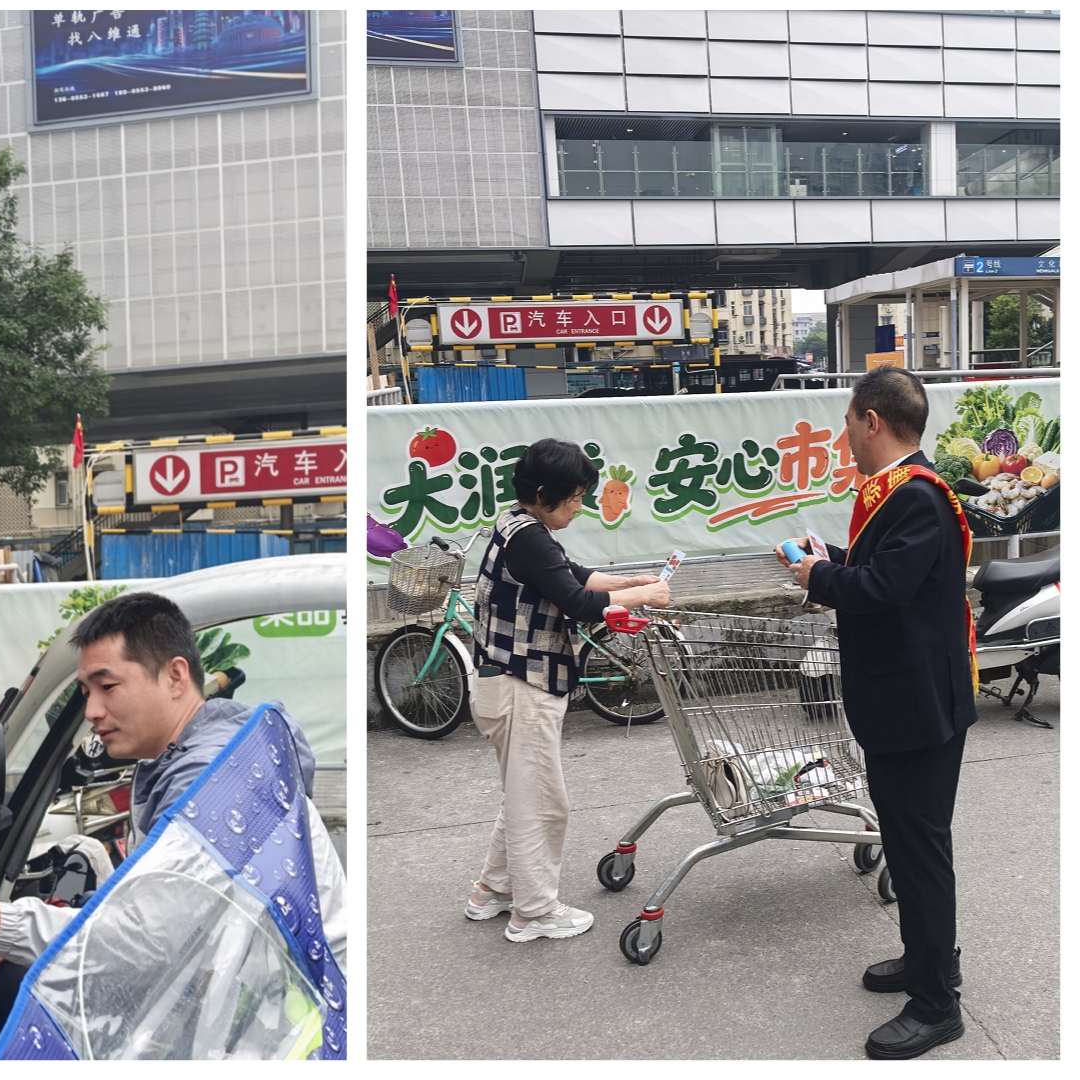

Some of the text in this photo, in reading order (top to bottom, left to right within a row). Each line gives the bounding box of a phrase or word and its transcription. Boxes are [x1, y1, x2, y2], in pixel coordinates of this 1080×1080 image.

[51, 9, 125, 29] 单轨广告
[67, 24, 142, 46] 找八维通
[985, 260, 1002, 269] 号线
[1038, 260, 1060, 269] 文化
[527, 310, 626, 328] 汽车入口
[293, 477, 310, 485] CAR
[384, 442, 602, 535] 大润
